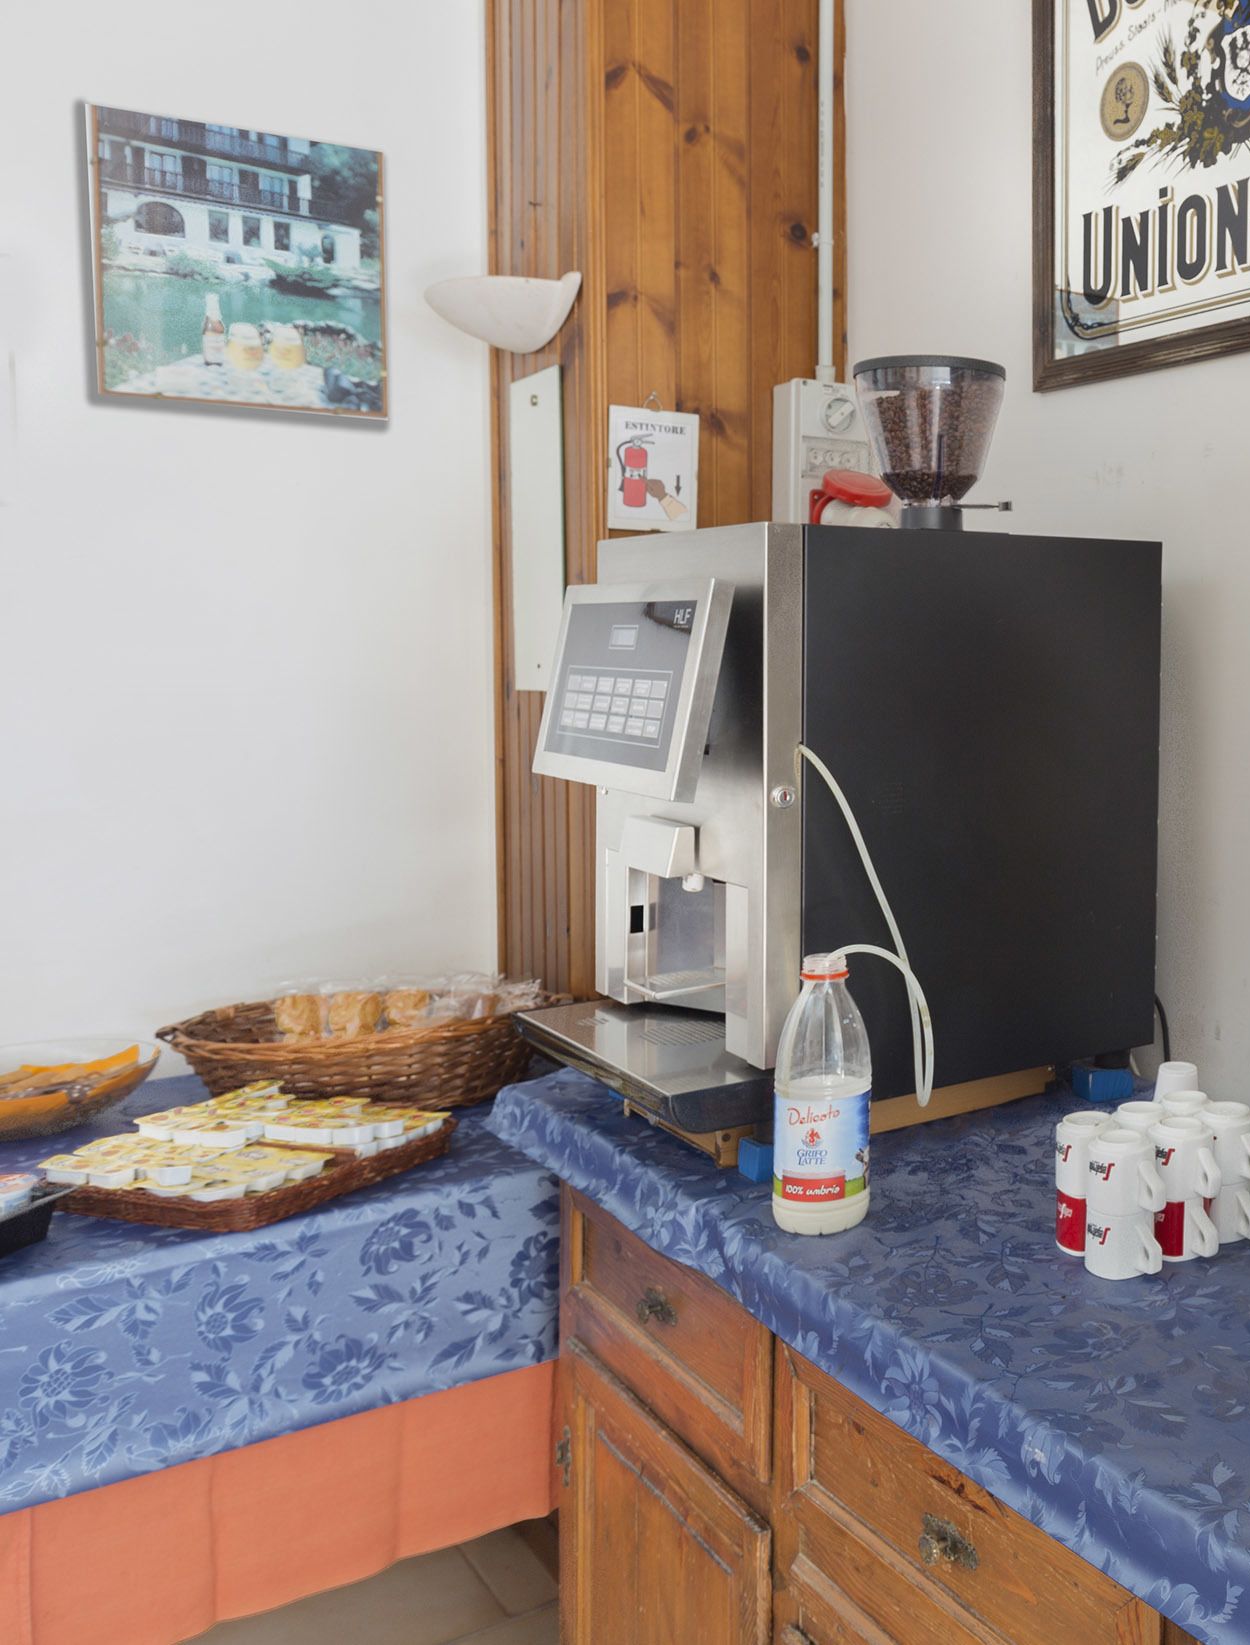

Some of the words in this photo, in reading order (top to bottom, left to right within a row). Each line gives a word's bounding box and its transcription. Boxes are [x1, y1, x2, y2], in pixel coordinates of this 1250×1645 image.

[625, 421, 687, 435] ESTINTORE
[673, 608, 692, 624] HLF
[787, 1104, 840, 1126] Delicato
[798, 1157, 827, 1166] LATTE
[785, 1184, 804, 1194] 100%
